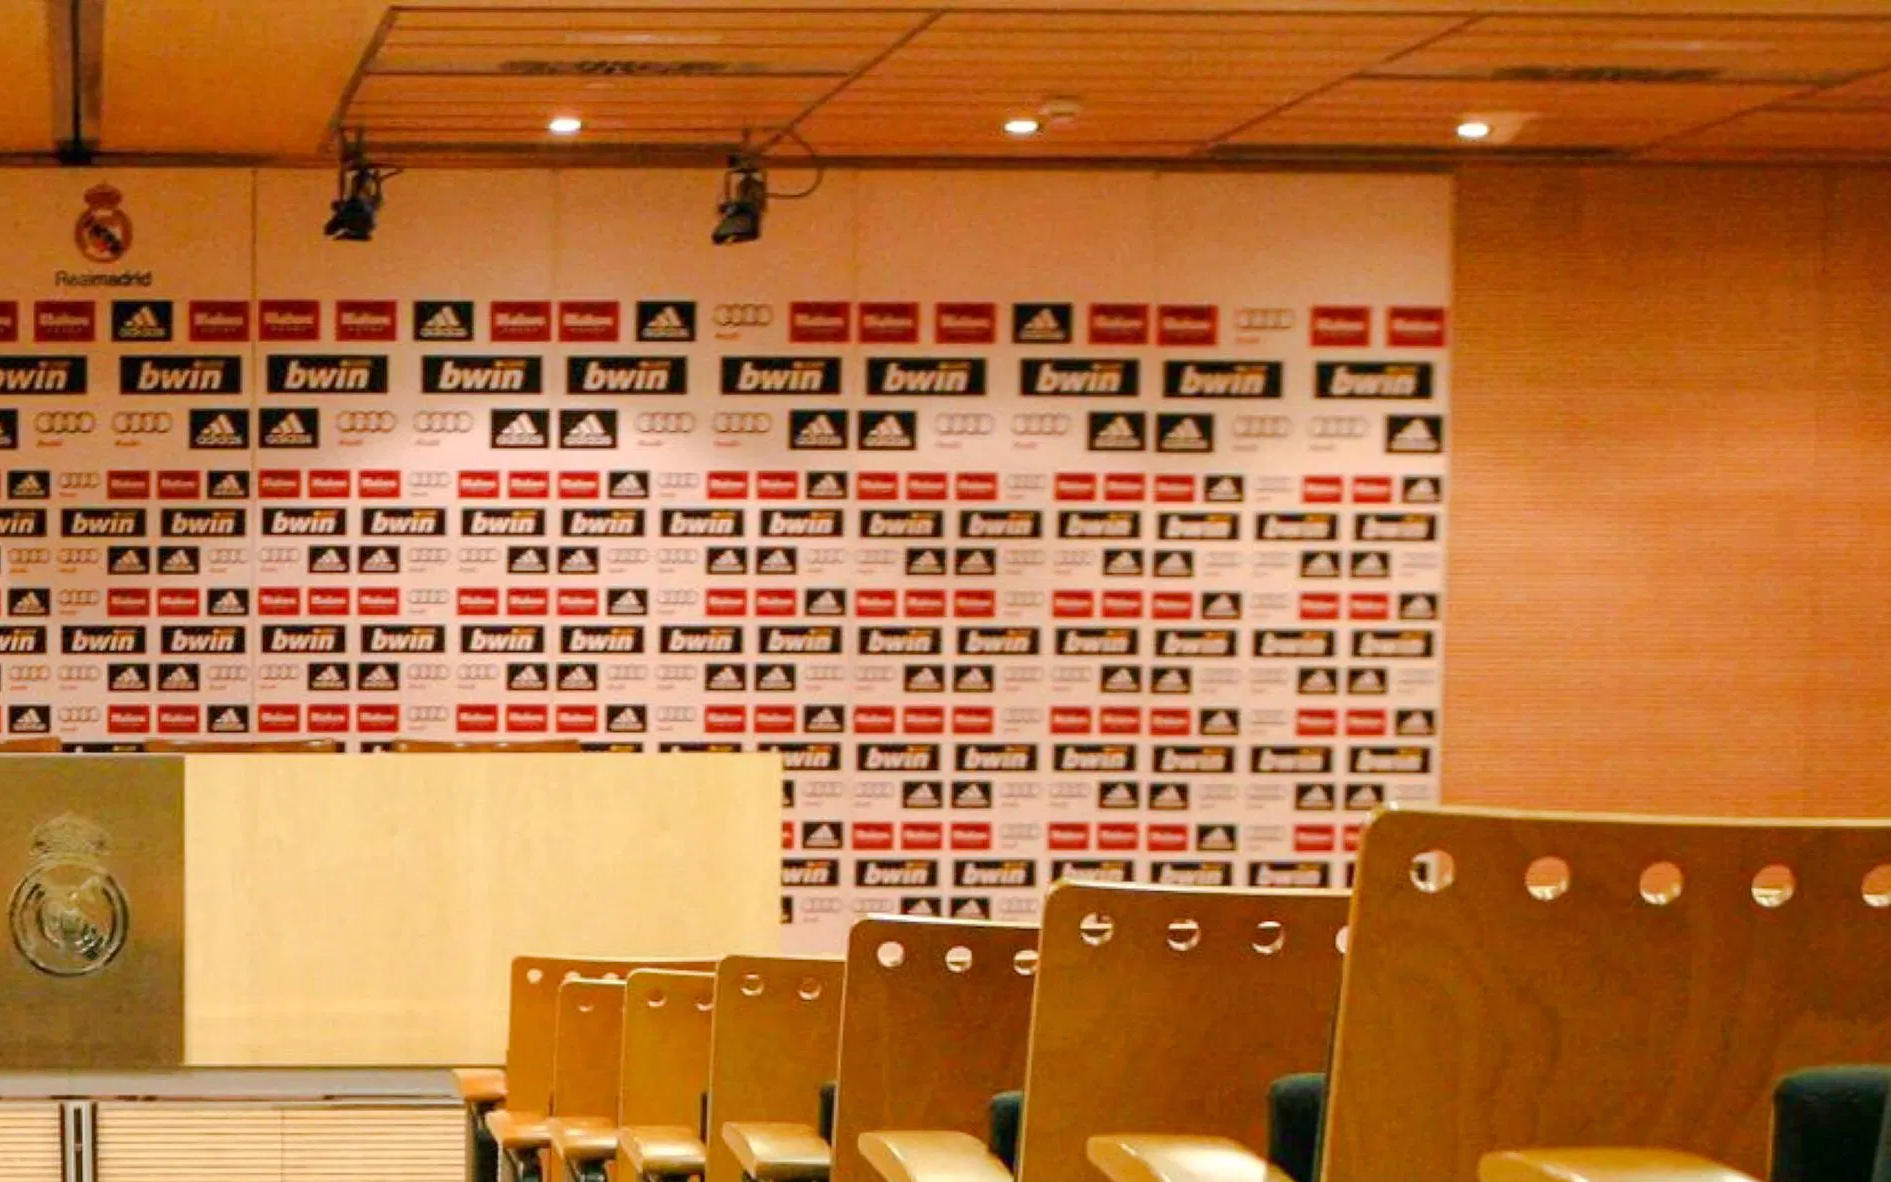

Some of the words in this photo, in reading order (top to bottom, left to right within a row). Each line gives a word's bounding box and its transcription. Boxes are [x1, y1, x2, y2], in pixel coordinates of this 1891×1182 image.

[138, 361, 222, 390] bwin
[285, 359, 369, 389] bwin
[439, 360, 523, 389] bwin
[583, 361, 668, 390] bwin
[738, 361, 824, 390] bwin
[883, 362, 969, 391] bwin
[72, 511, 134, 533] bwin
[172, 511, 234, 533] bwin
[272, 510, 335, 532] bwin
[371, 511, 436, 533] bwin
[471, 510, 536, 532] bwin
[570, 511, 636, 533] bwin
[72, 628, 135, 650] bwin
[171, 628, 234, 650] bwin
[271, 628, 336, 650] bwin
[371, 628, 435, 650] bwin
[470, 627, 535, 649] bwin
[569, 628, 635, 650] bwin
